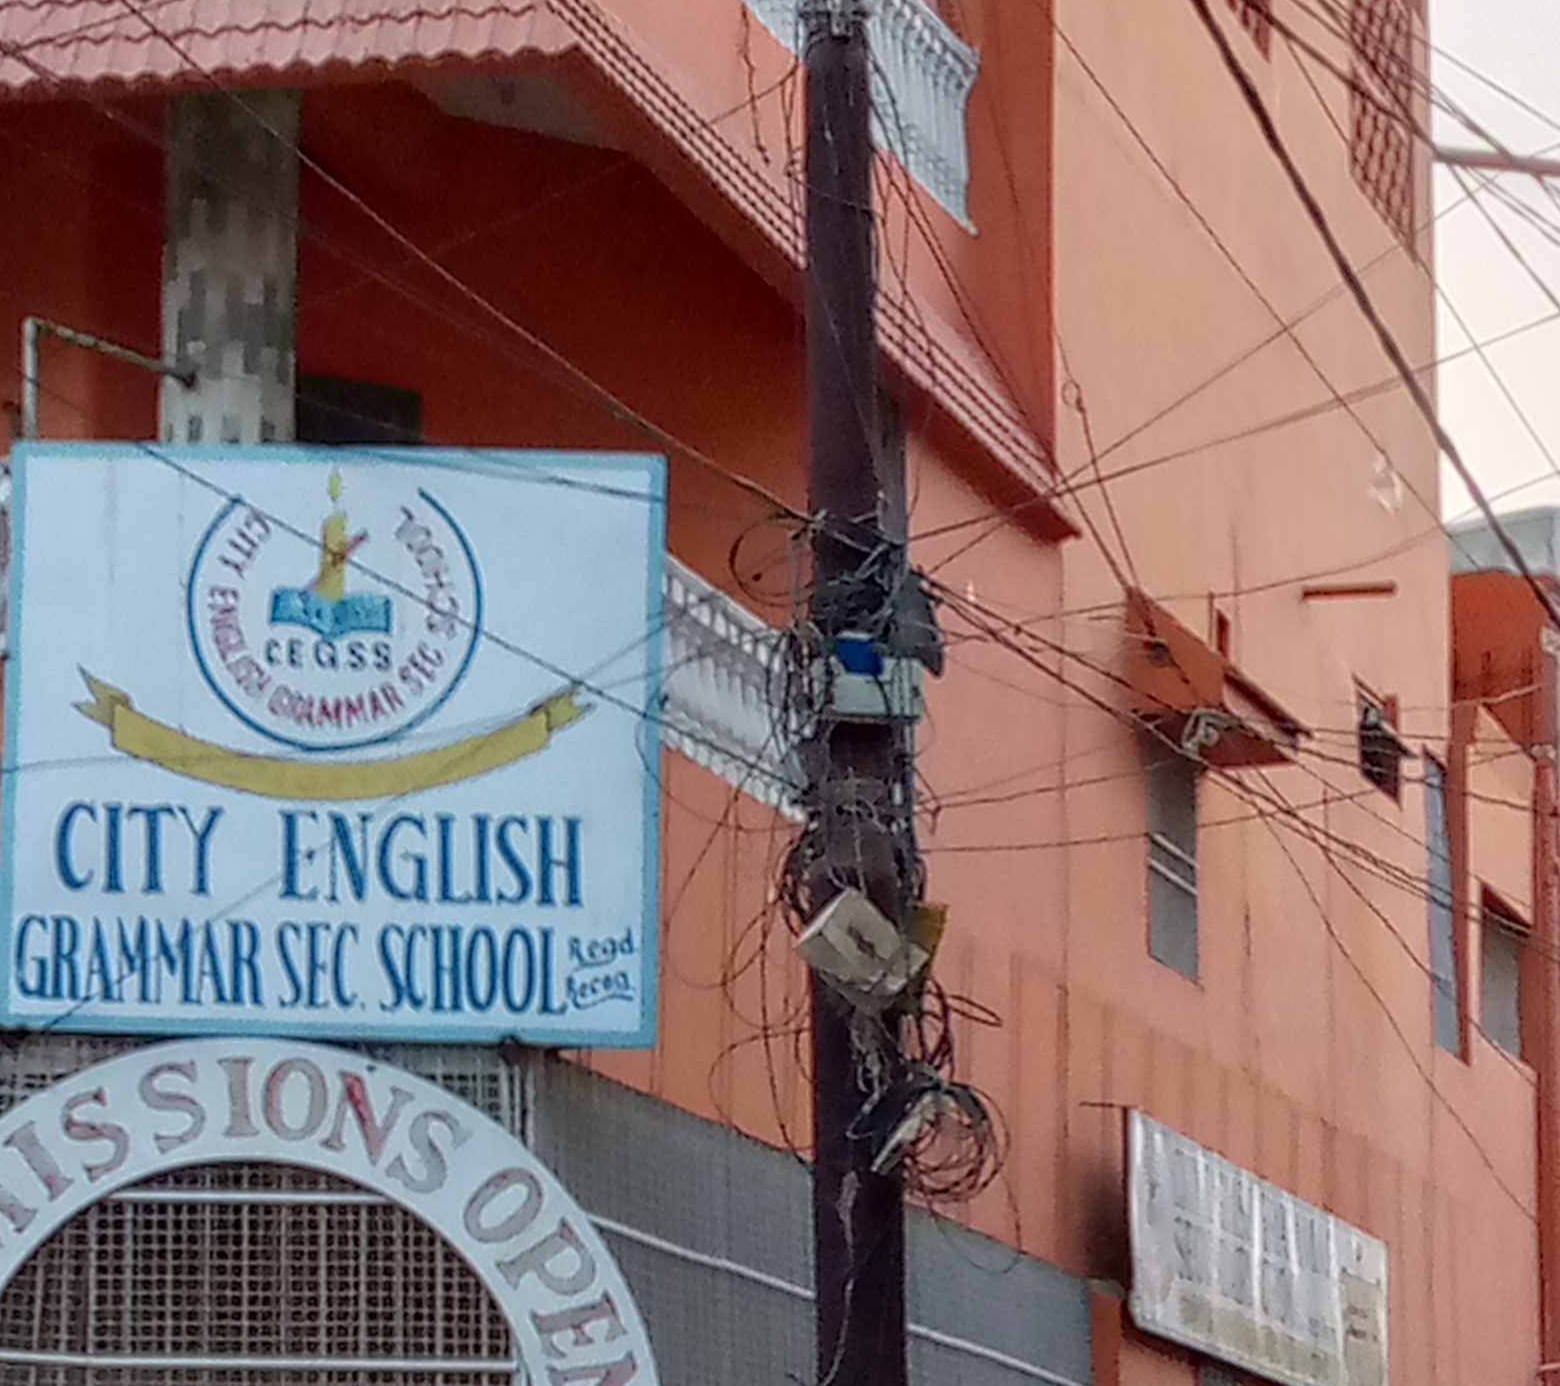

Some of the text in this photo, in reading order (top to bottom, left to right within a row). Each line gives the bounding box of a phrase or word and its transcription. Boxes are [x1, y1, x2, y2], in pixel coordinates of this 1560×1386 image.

[218, 508, 272, 580] CITY
[209, 586, 271, 697] ENGLISH
[398, 639, 445, 698] SEC
[54, 800, 584, 908] CITY ENGLISH
[14, 914, 263, 1008] GRAMMAR
[377, 923, 568, 1015] SCHOOL
